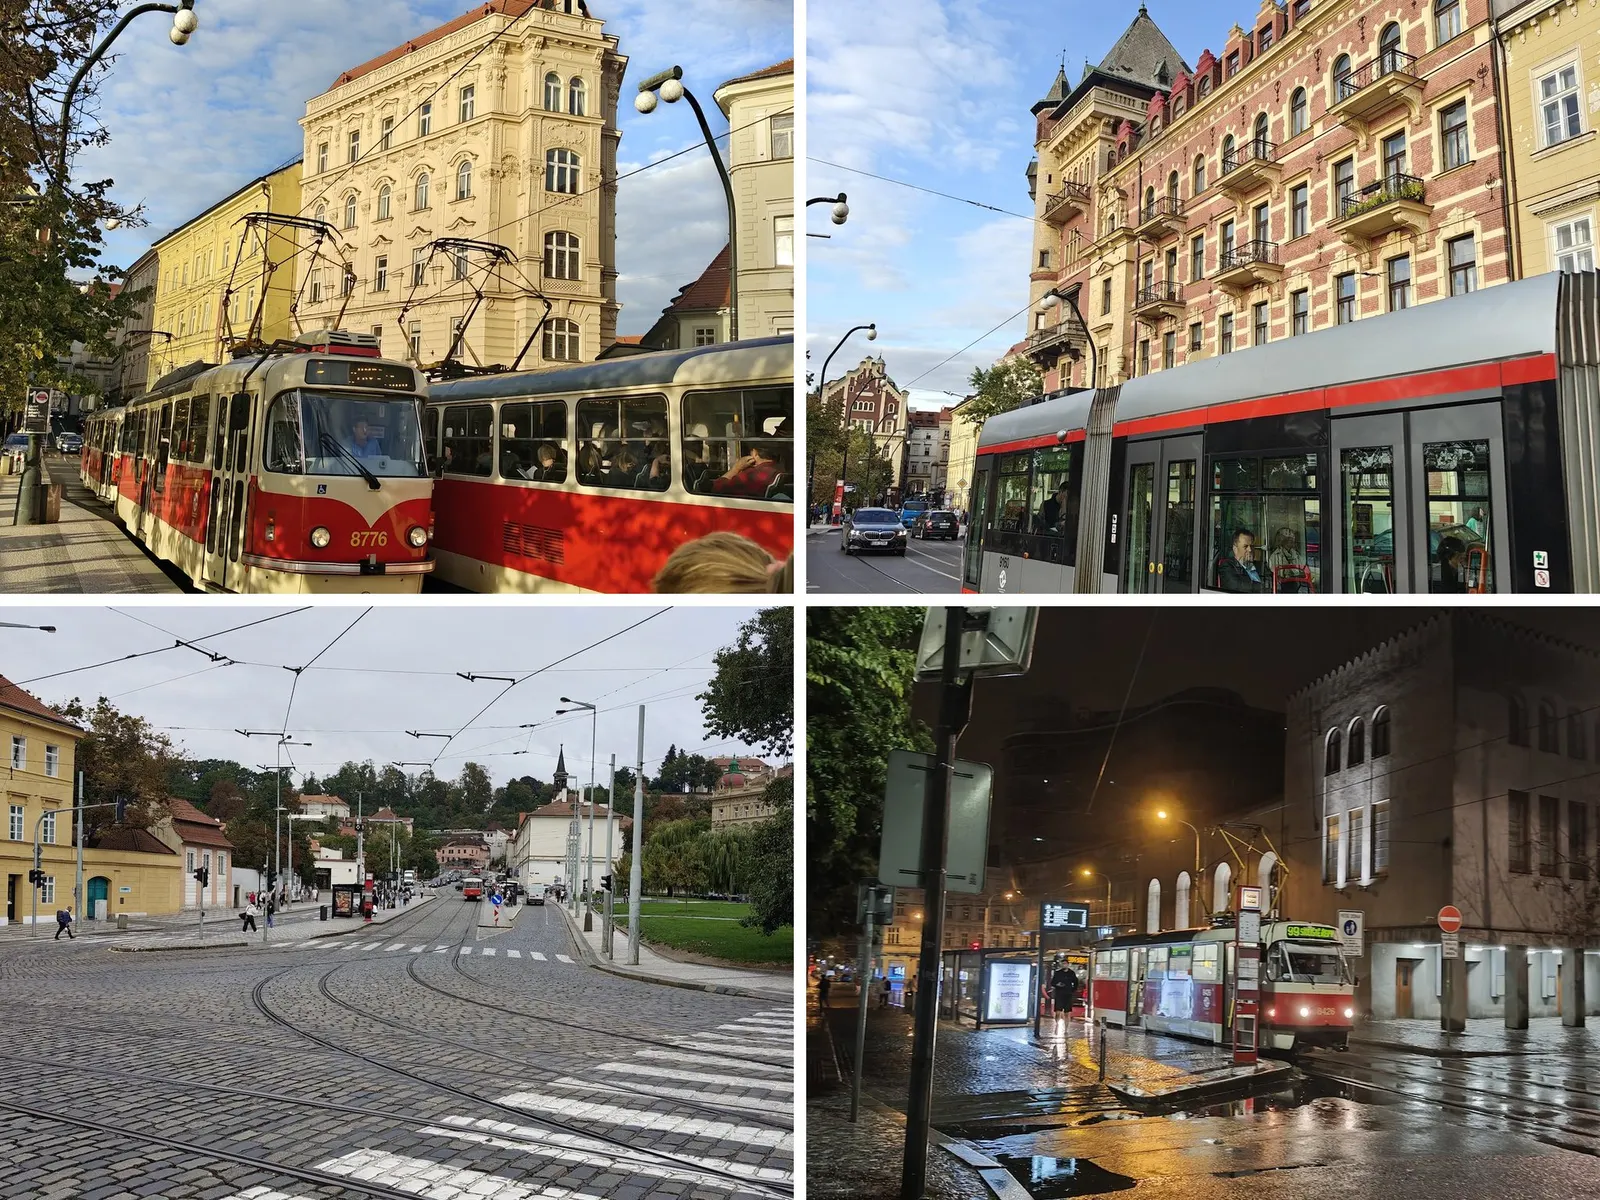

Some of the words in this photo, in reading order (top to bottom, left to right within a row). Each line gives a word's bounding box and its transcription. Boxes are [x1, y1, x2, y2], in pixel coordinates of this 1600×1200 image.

[350, 531, 388, 547] 8776
[1287, 926, 1300, 937] 99
[1316, 1007, 1336, 1016] 8426
